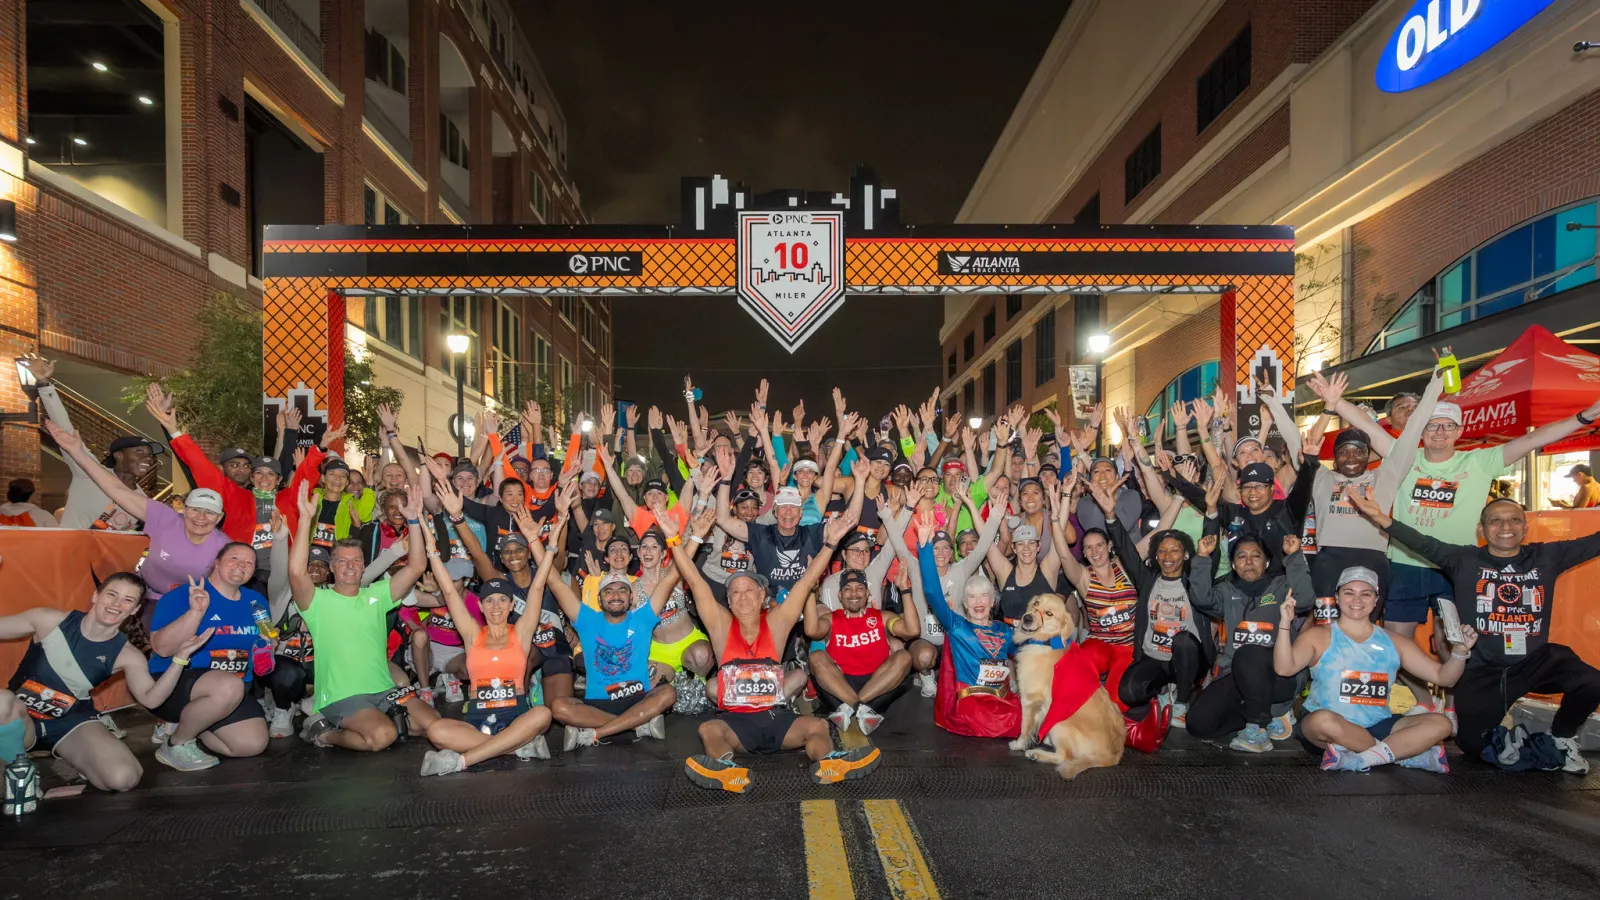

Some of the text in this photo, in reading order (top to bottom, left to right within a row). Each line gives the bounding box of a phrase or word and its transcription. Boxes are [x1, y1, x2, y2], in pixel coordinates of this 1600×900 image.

[1396, 0, 1481, 71] OLD
[786, 214, 808, 224] PNC
[774, 242, 809, 270] 10
[590, 256, 631, 272] PNC
[972, 257, 1020, 268] ATLANTA
[1463, 400, 1517, 426] TLANTA
[298, 424, 314, 434] NC
[1465, 423, 1484, 433] ACK
[1414, 488, 1454, 501] B5009
[721, 559, 748, 569] E8313
[1482, 569, 1498, 579] IT'S
[1515, 570, 1539, 582] TIME
[1507, 606, 1526, 614] PNC
[1100, 612, 1130, 627] C5858
[1488, 612, 1535, 623] ATLANTA
[215, 625, 260, 635] ATLANTA
[1476, 616, 1486, 632] 10
[1532, 618, 1543, 633] 5K
[835, 628, 881, 648] FLASH
[1234, 631, 1271, 643] E7599
[210, 661, 248, 671] D6557
[478, 688, 514, 700] C6085
[610, 682, 643, 701] A4200
[737, 683, 775, 693] C5829
[1341, 682, 1386, 697] D7218
[16, 693, 64, 717] C5473
